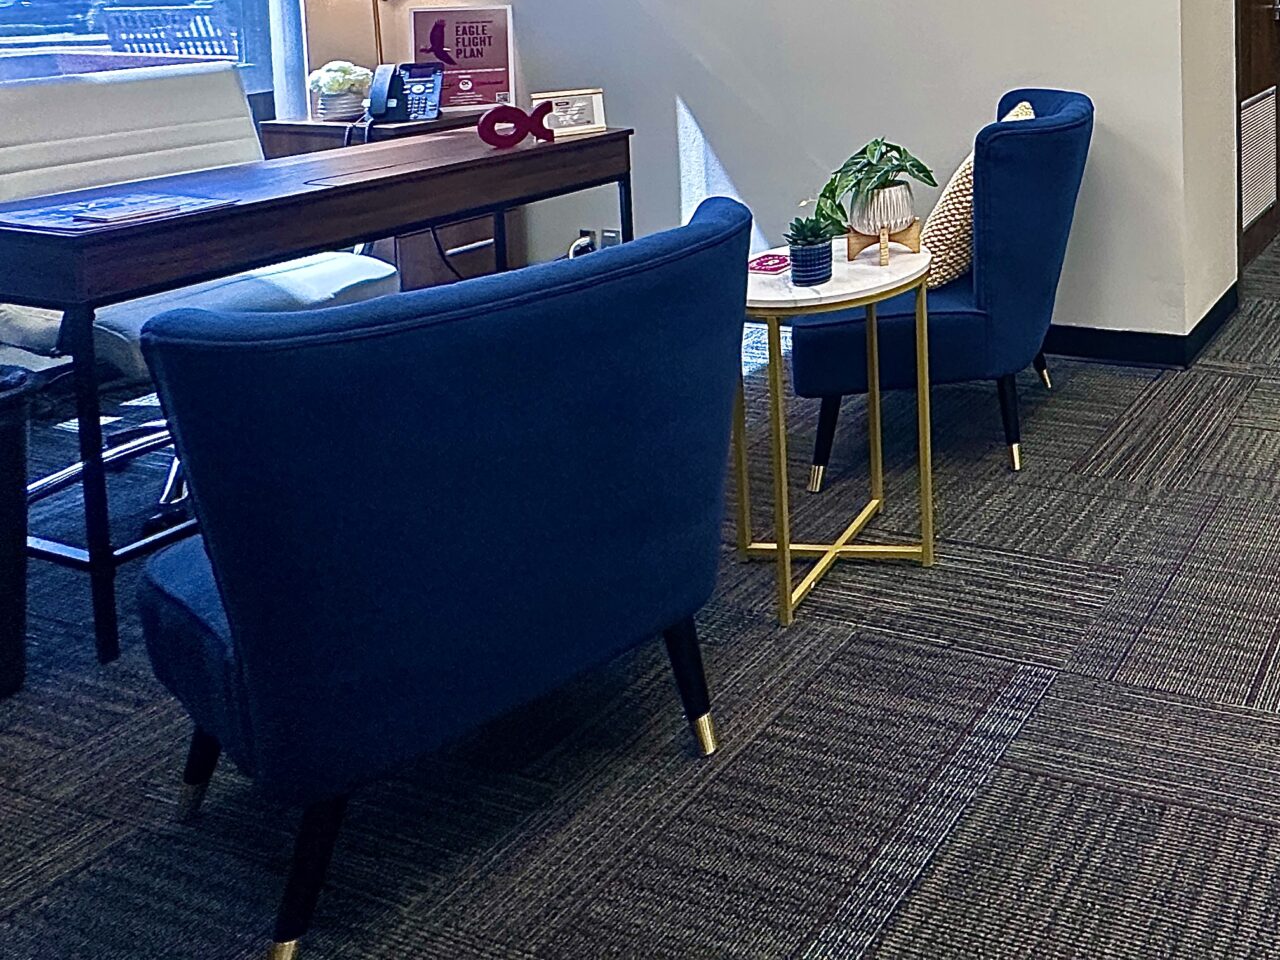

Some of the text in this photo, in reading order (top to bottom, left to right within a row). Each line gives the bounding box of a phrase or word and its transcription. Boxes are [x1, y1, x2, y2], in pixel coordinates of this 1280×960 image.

[455, 25, 488, 36] EAGLE
[455, 36, 493, 47] FLIGHT
[456, 48, 484, 59] PLAN
